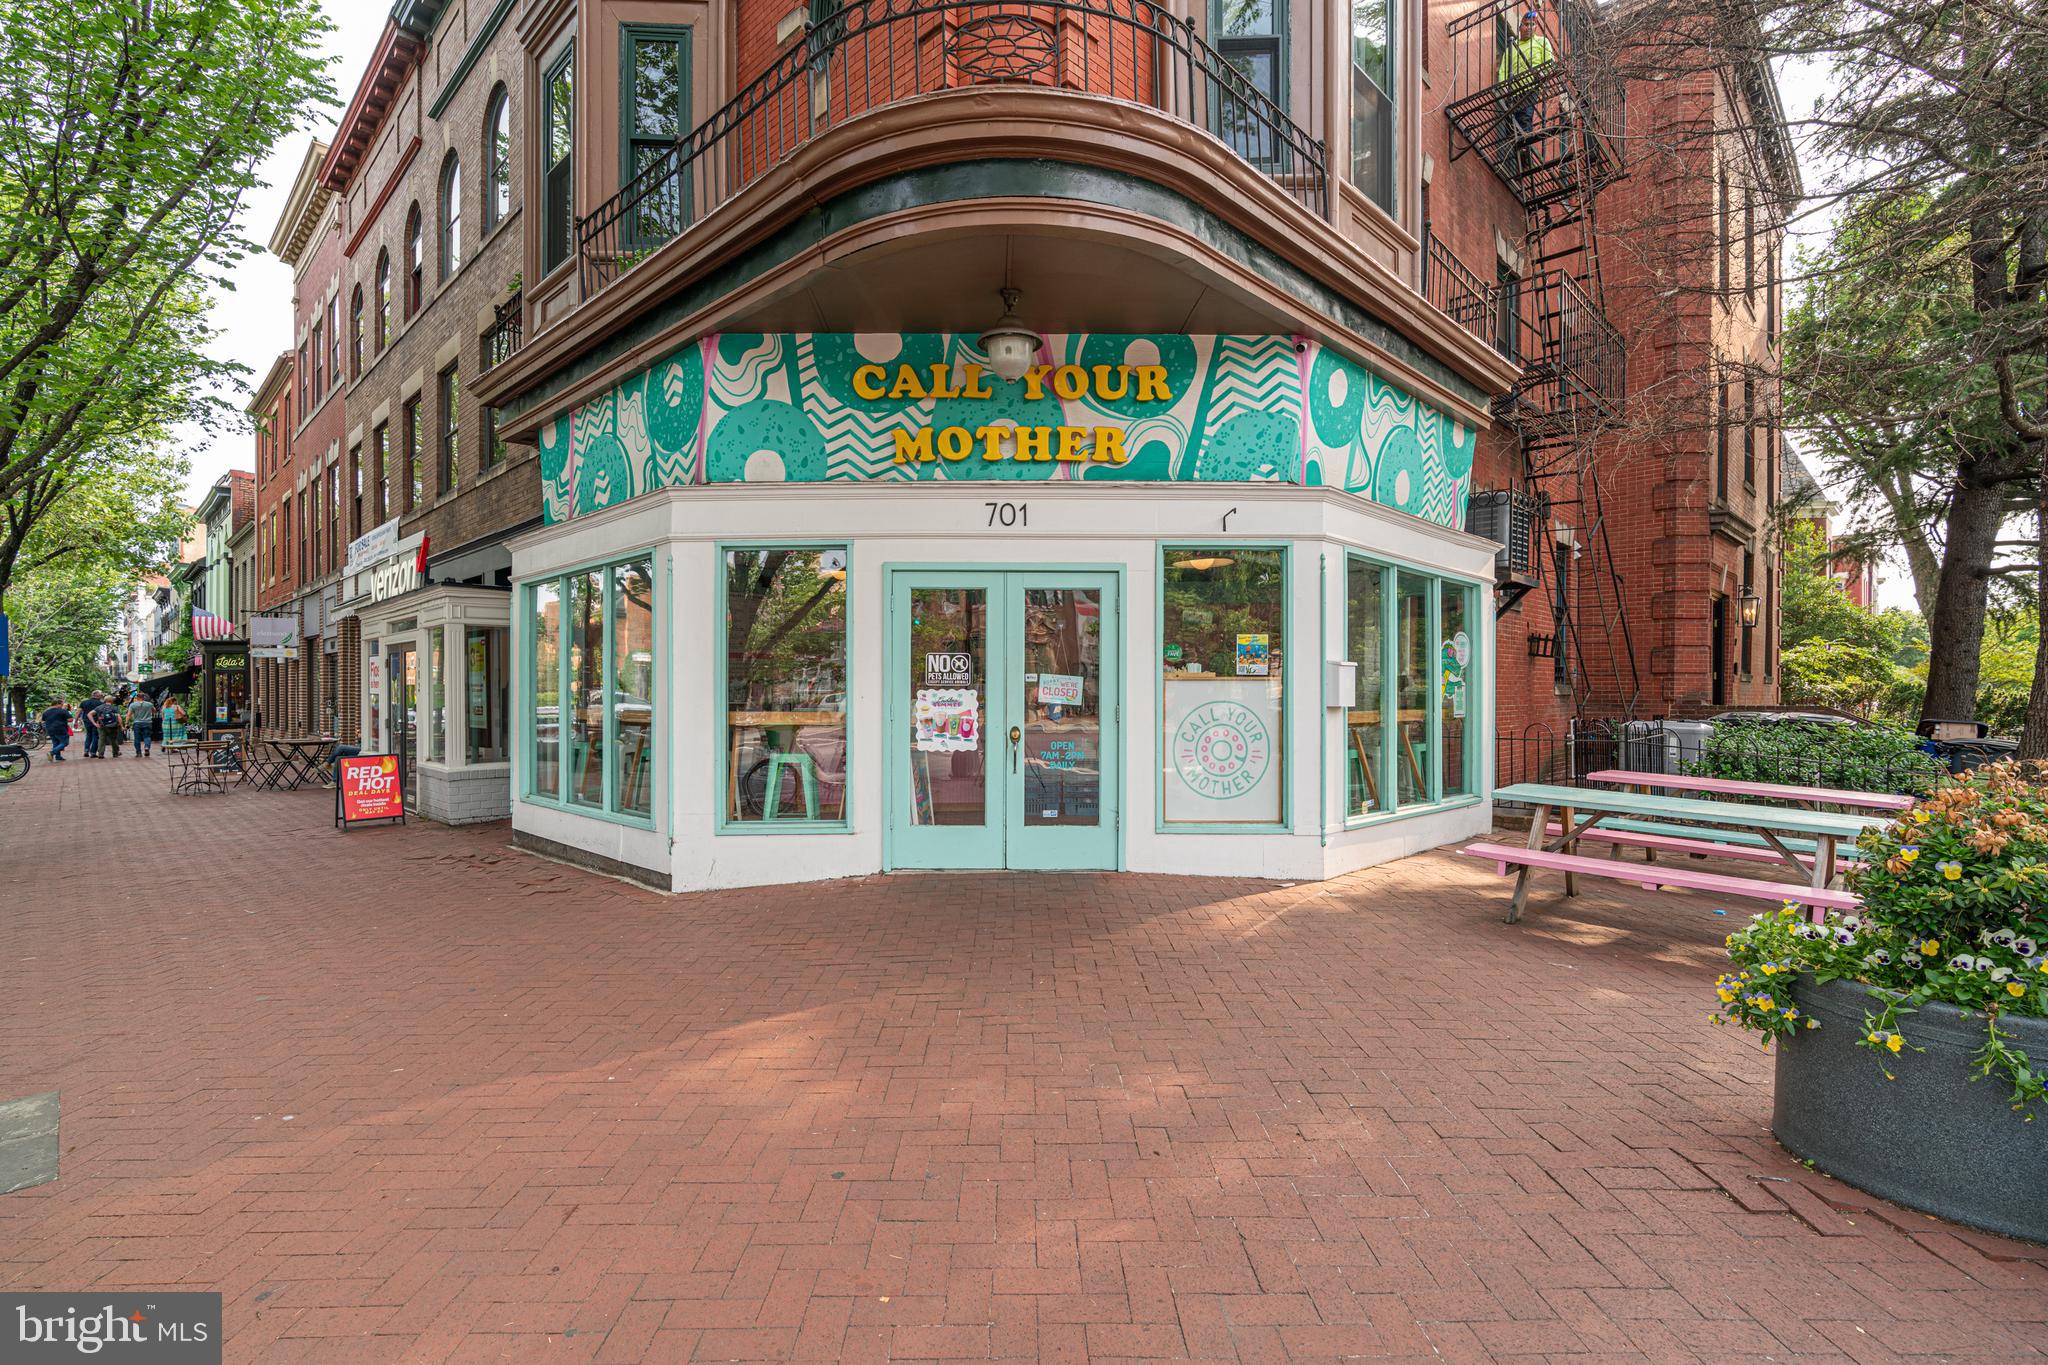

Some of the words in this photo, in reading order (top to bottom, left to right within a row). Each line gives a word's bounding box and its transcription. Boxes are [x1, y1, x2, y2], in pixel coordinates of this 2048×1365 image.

[852, 363, 993, 400] CALL
[1023, 364, 1174, 401] YOUR
[891, 425, 1129, 464] MOTHER
[985, 502, 1028, 527] 701
[371, 557, 416, 602] verizon
[216, 657, 245, 669] Lola's
[928, 655, 951, 672] NO
[928, 672, 942, 680] PETS
[943, 672, 969, 680] ALLOWED
[1042, 686, 1079, 697] CLOSED
[1181, 707, 1220, 742] CALL
[1228, 707, 1263, 744] YOUR
[1050, 741, 1075, 750] OPEN
[347, 766, 382, 779] RED
[1050, 761, 1075, 769] DAILY
[359, 776, 394, 791] HOT
[1186, 769, 1255, 795] MOTHER
